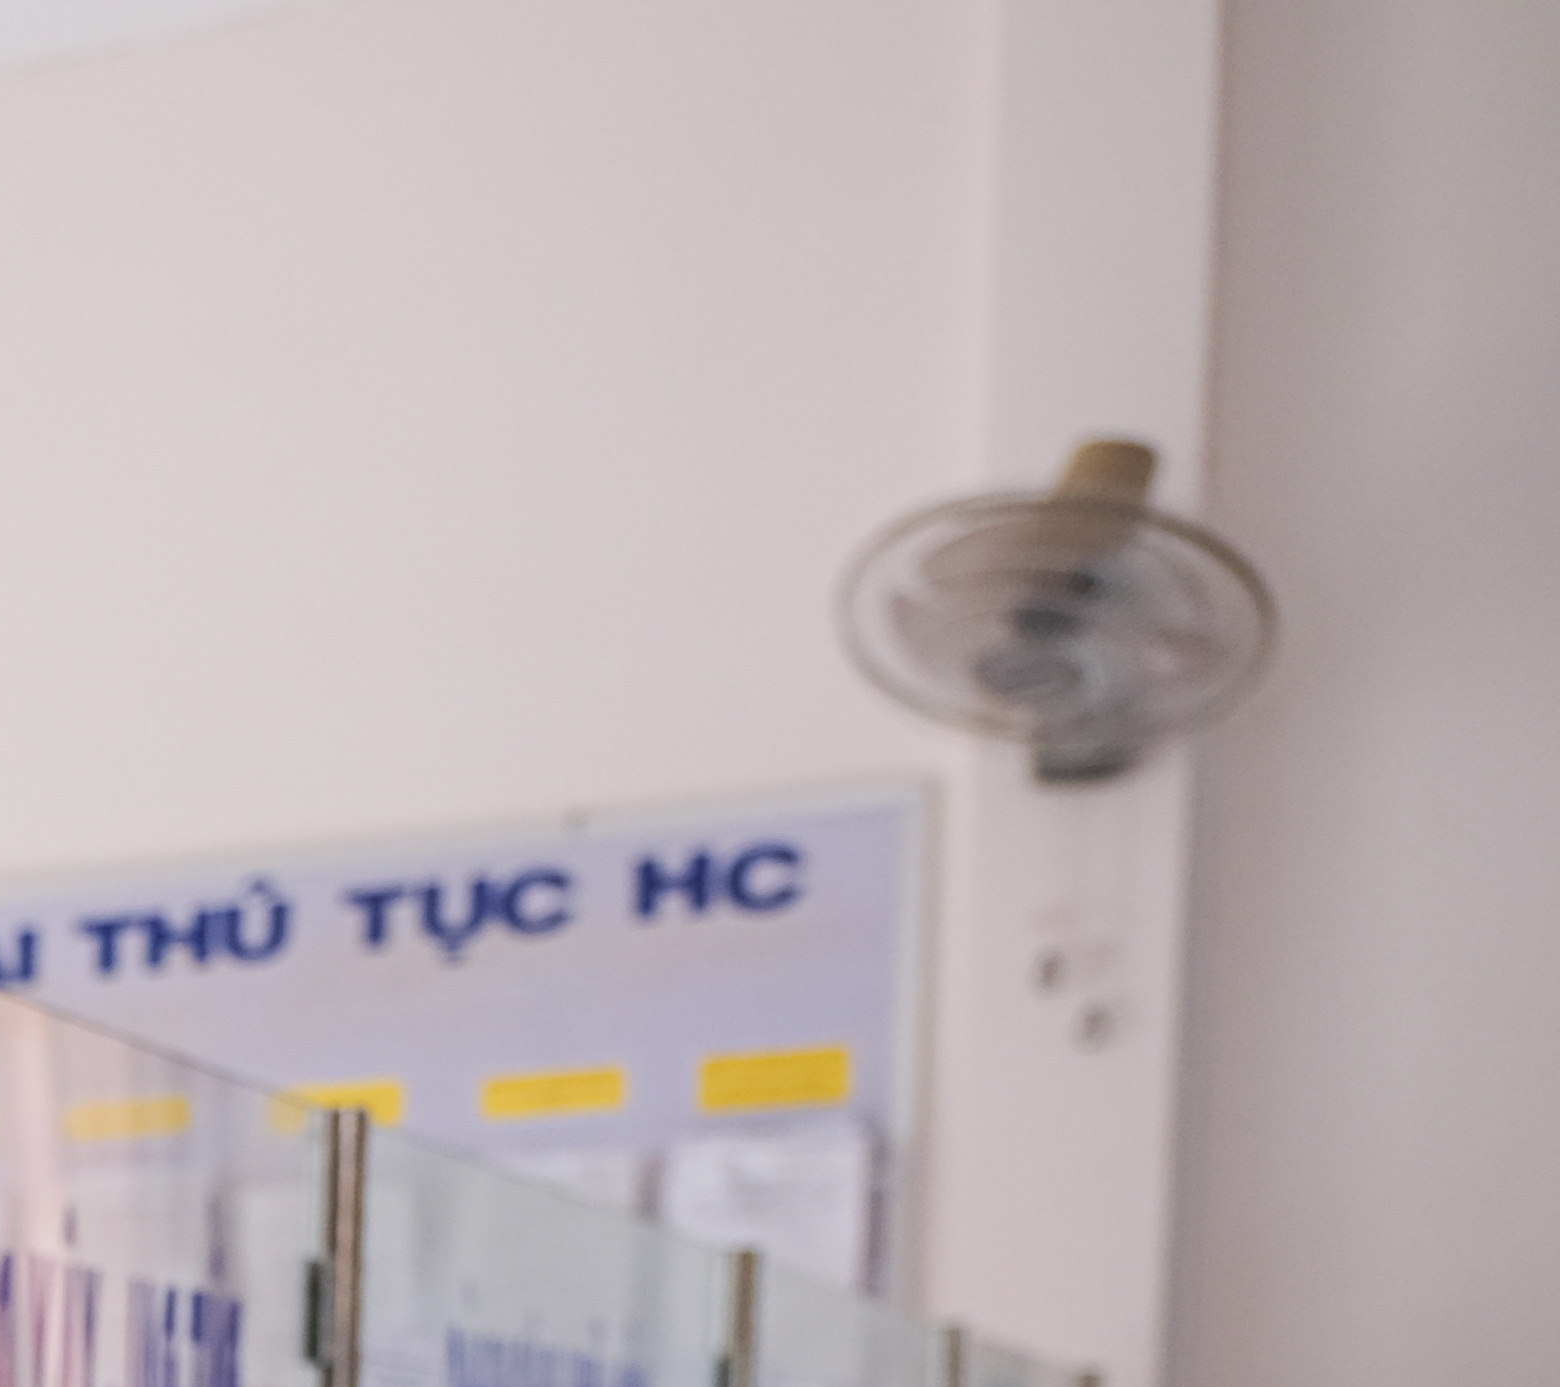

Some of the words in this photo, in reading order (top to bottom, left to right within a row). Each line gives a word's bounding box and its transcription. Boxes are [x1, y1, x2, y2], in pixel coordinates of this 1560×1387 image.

[83, 877, 289, 973] THỦ
[352, 867, 573, 962] TỤC
[636, 843, 801, 918] HC
